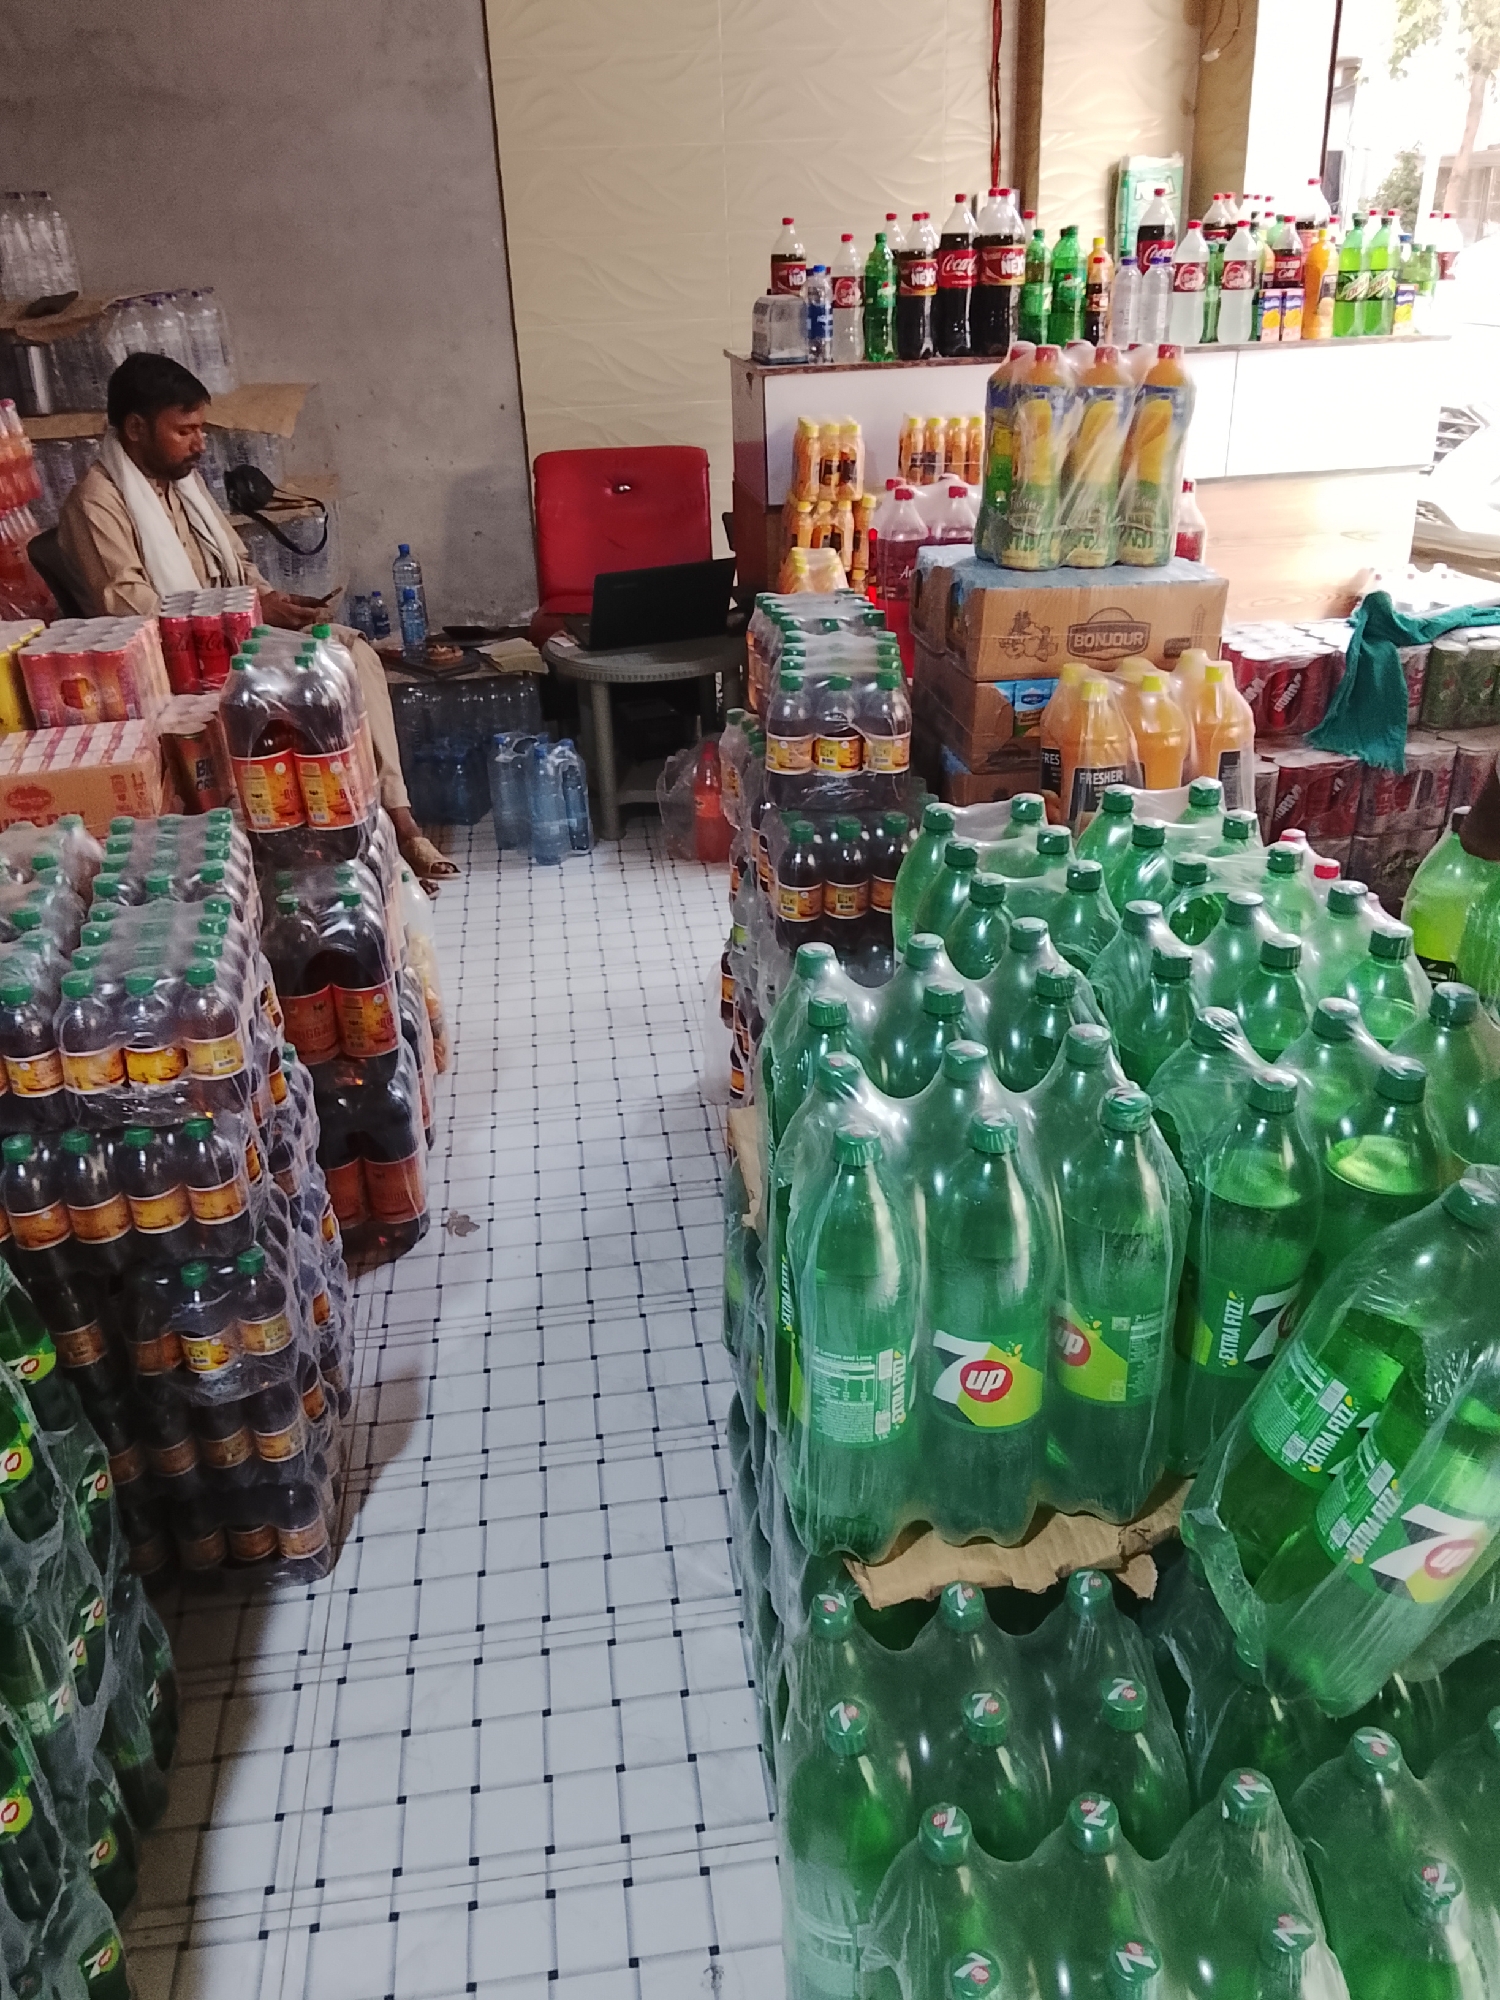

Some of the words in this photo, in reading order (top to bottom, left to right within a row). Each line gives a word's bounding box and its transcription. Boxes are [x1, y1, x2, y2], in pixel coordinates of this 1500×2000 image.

[1073, 631, 1144, 649] BONJOUR
[1079, 769, 1124, 786] FRESHER
[1224, 1299, 1245, 1326] FIZZ
[1219, 1328, 1240, 1360] EXTRA
[892, 1354, 906, 1387] FIZZ
[892, 1384, 906, 1424] EXTRA
[1302, 1431, 1341, 1467] EXTRA
[1326, 1403, 1358, 1435] FIZZ
